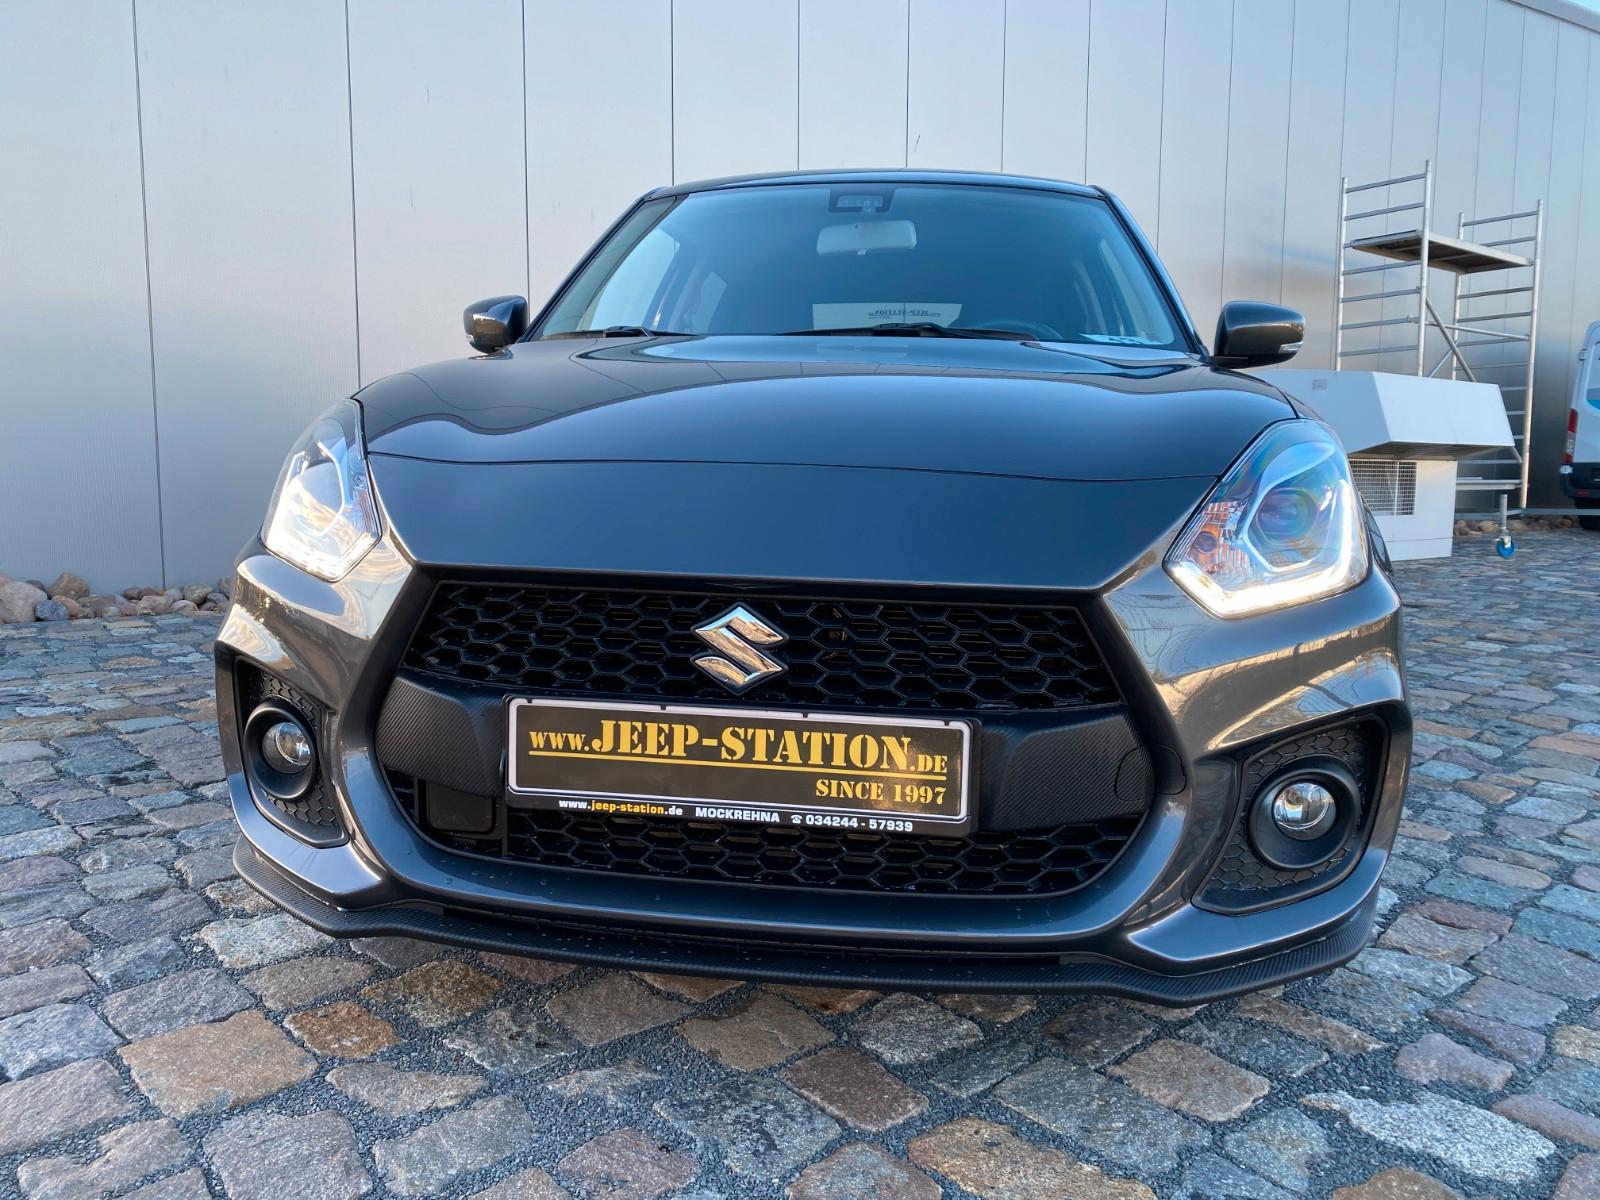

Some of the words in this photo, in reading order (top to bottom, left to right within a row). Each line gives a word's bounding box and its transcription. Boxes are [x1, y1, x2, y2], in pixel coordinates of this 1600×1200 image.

[815, 778, 884, 800] SINCE
[893, 784, 947, 805] 1997
[558, 799, 683, 816] www.jeep-station.de
[695, 807, 780, 823] MOCKREHNA
[805, 814, 858, 828] 034244
[868, 819, 913, 832] 57939
